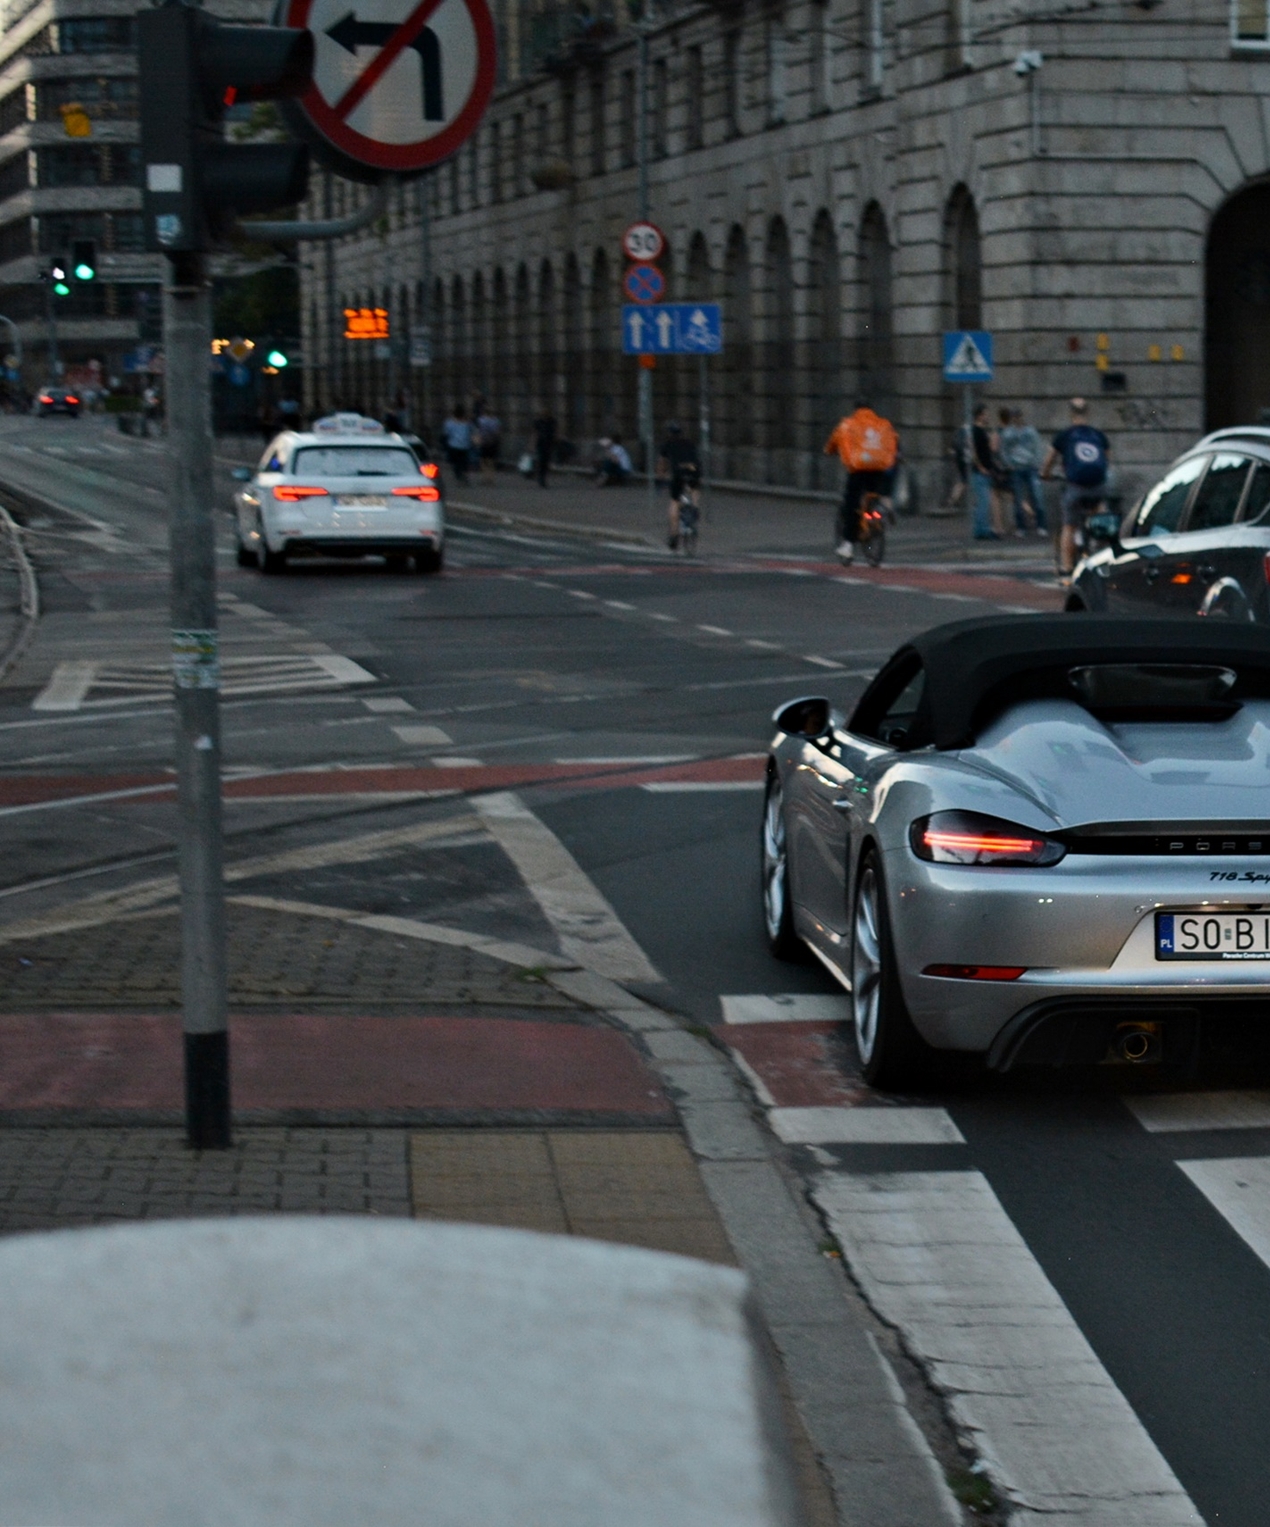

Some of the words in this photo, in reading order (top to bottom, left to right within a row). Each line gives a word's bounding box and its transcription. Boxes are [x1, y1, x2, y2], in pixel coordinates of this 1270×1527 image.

[630, 233, 657, 253] 30
[1209, 872, 1238, 881] 718
[1160, 939, 1173, 948] PL
